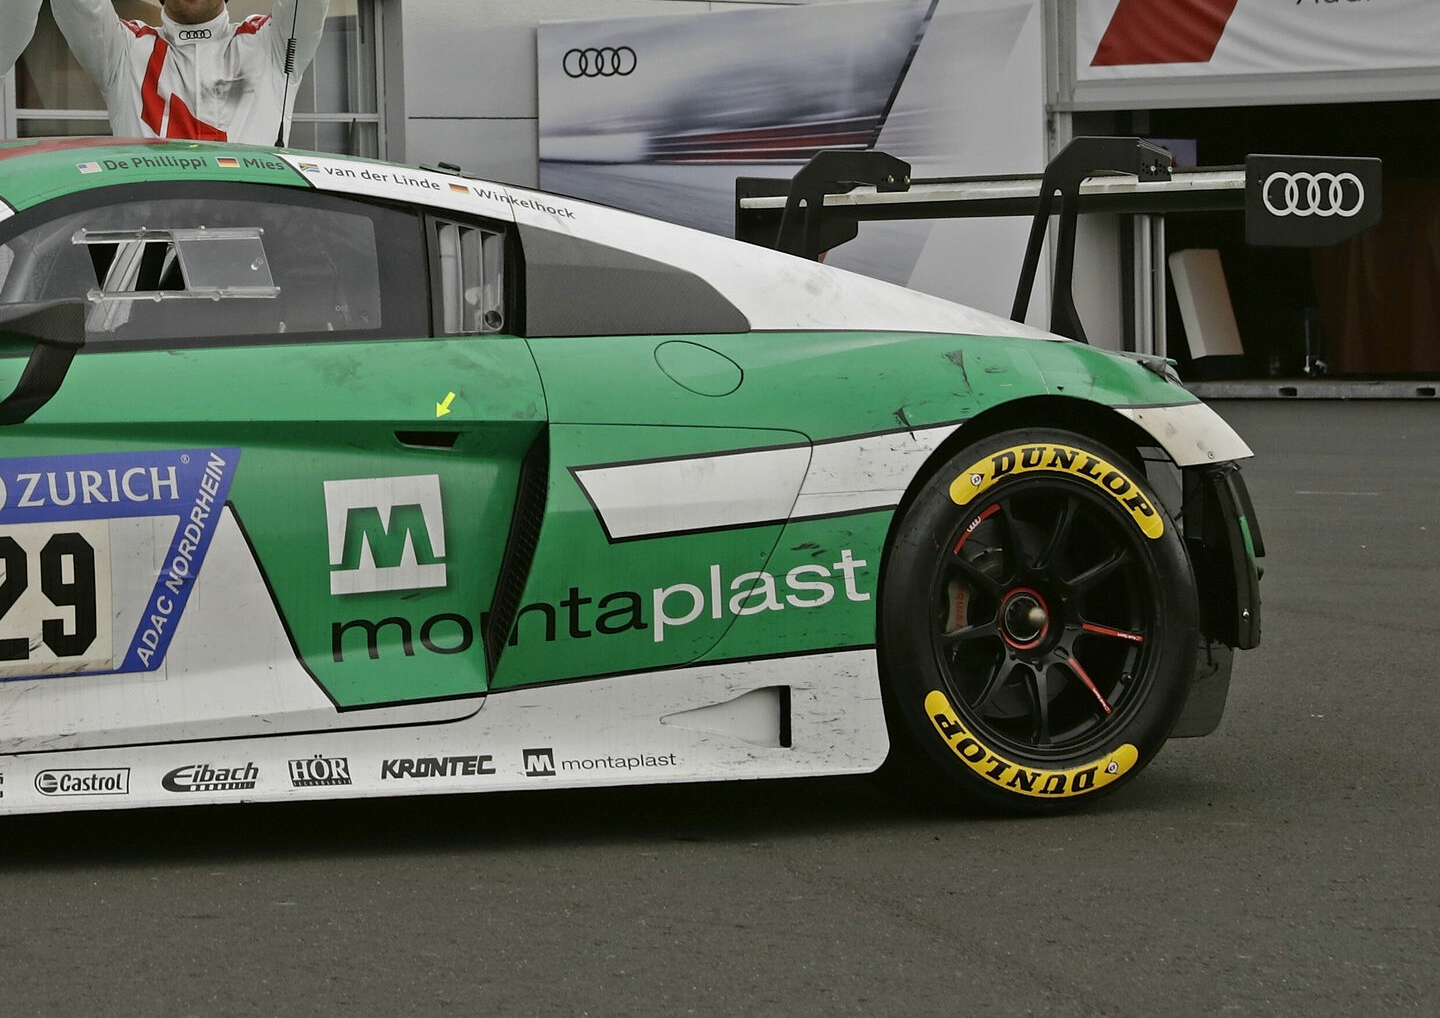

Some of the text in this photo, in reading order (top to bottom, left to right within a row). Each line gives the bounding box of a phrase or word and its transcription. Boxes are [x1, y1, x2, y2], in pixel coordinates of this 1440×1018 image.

[103, 156, 207, 172] De Phillippi
[242, 157, 285, 171] Mies
[324, 166, 441, 192] van der Linde
[473, 186, 578, 221] Winkelhock
[17, 467, 181, 508] ZURICH
[990, 446, 1154, 519] DUNLOP
[136, 452, 226, 668] ADAC NORDRHEIN
[332, 548, 871, 664] montaplast
[290, 754, 350, 781] HÖR
[381, 755, 496, 780] KRONTEC
[561, 752, 677, 772] montaplast
[934, 713, 1099, 796] DUNLOP
[60, 773, 124, 793] Castrol
[161, 762, 259, 793] Eibach
